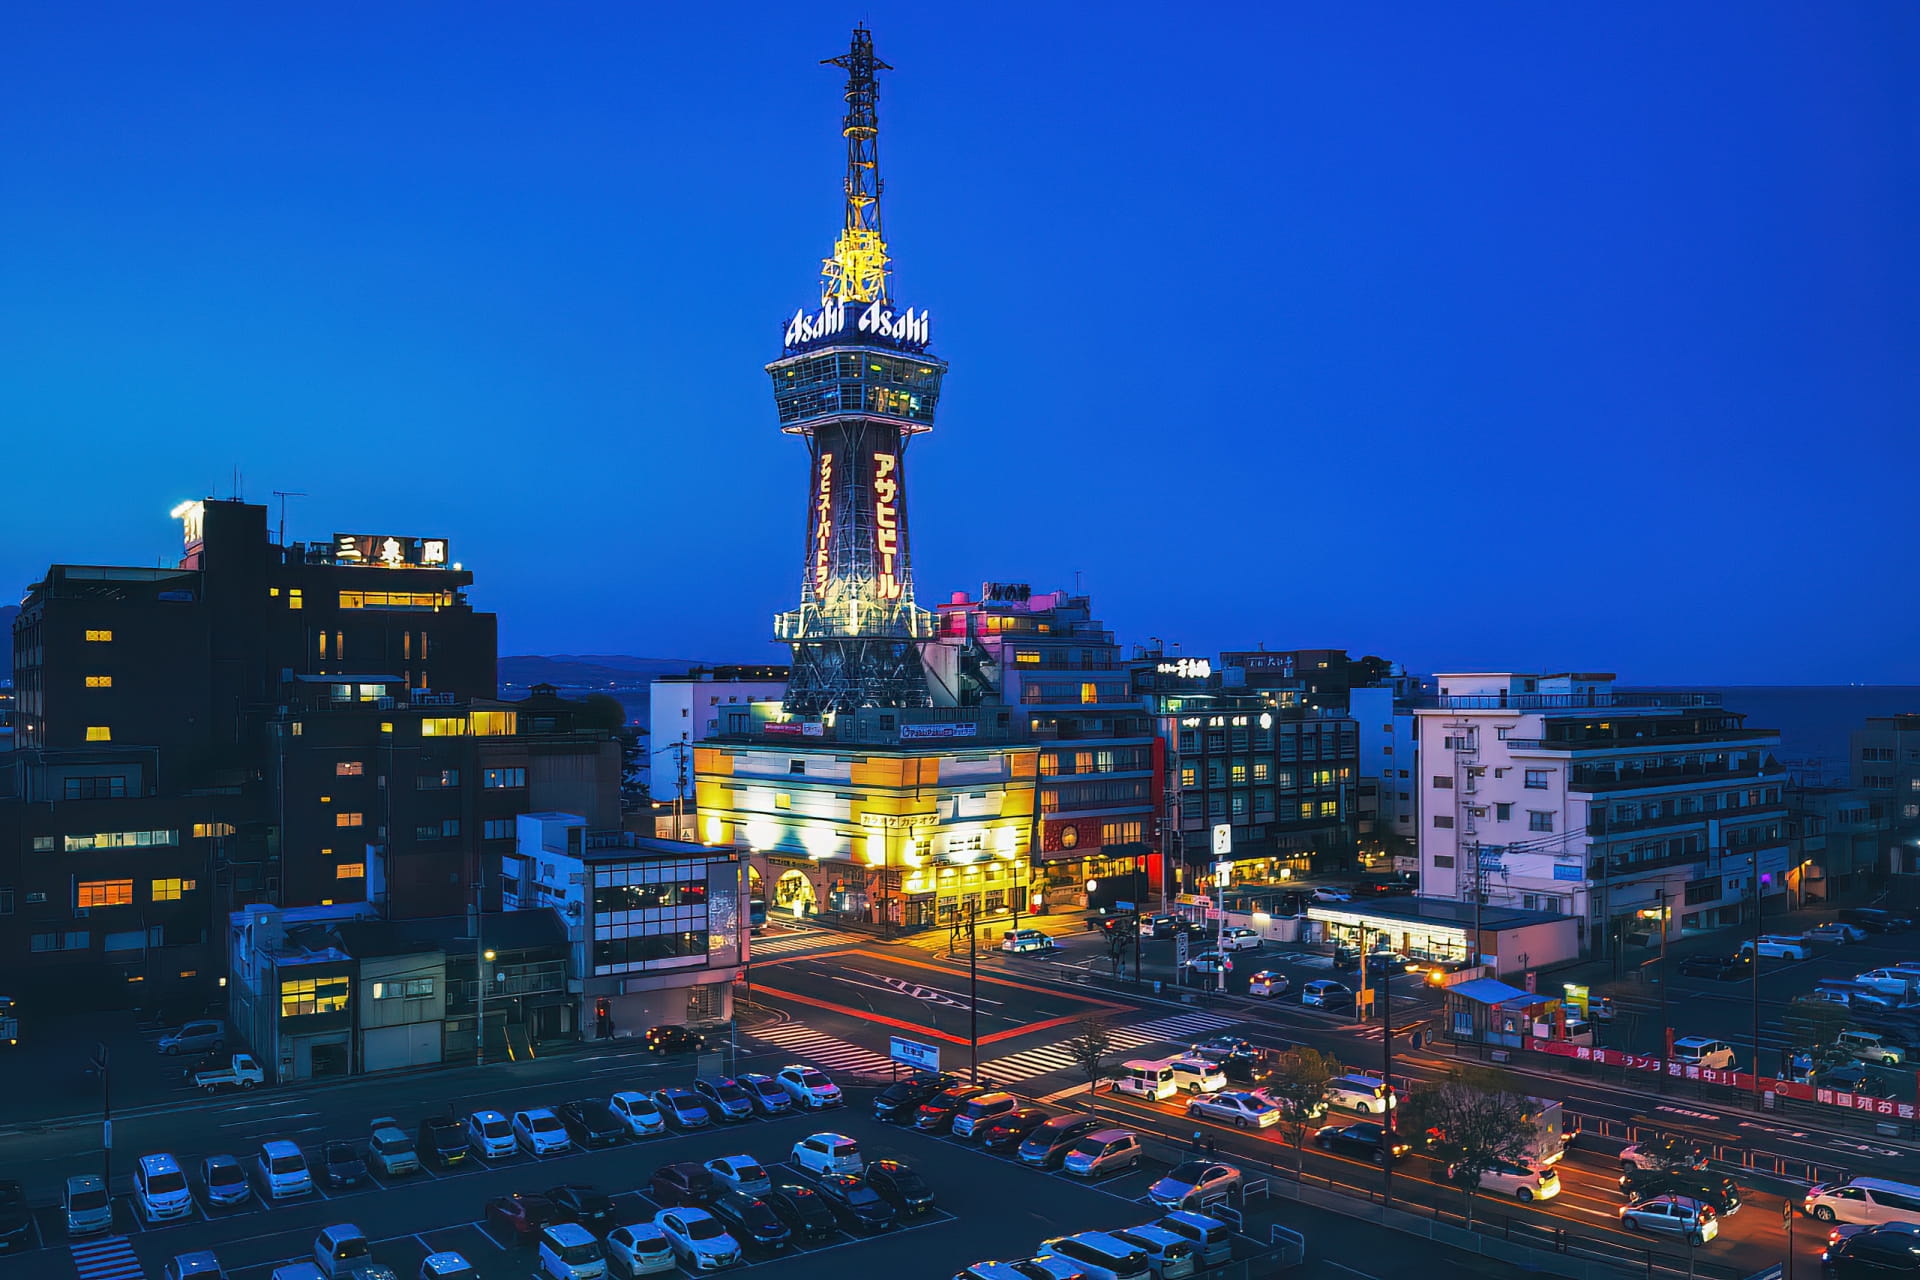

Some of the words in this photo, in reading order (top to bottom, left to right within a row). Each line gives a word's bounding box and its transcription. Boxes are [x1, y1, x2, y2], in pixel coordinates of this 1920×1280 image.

[785, 297, 845, 347] Asahi
[858, 299, 929, 344] Asahi
[873, 453, 900, 599] アサヒビール
